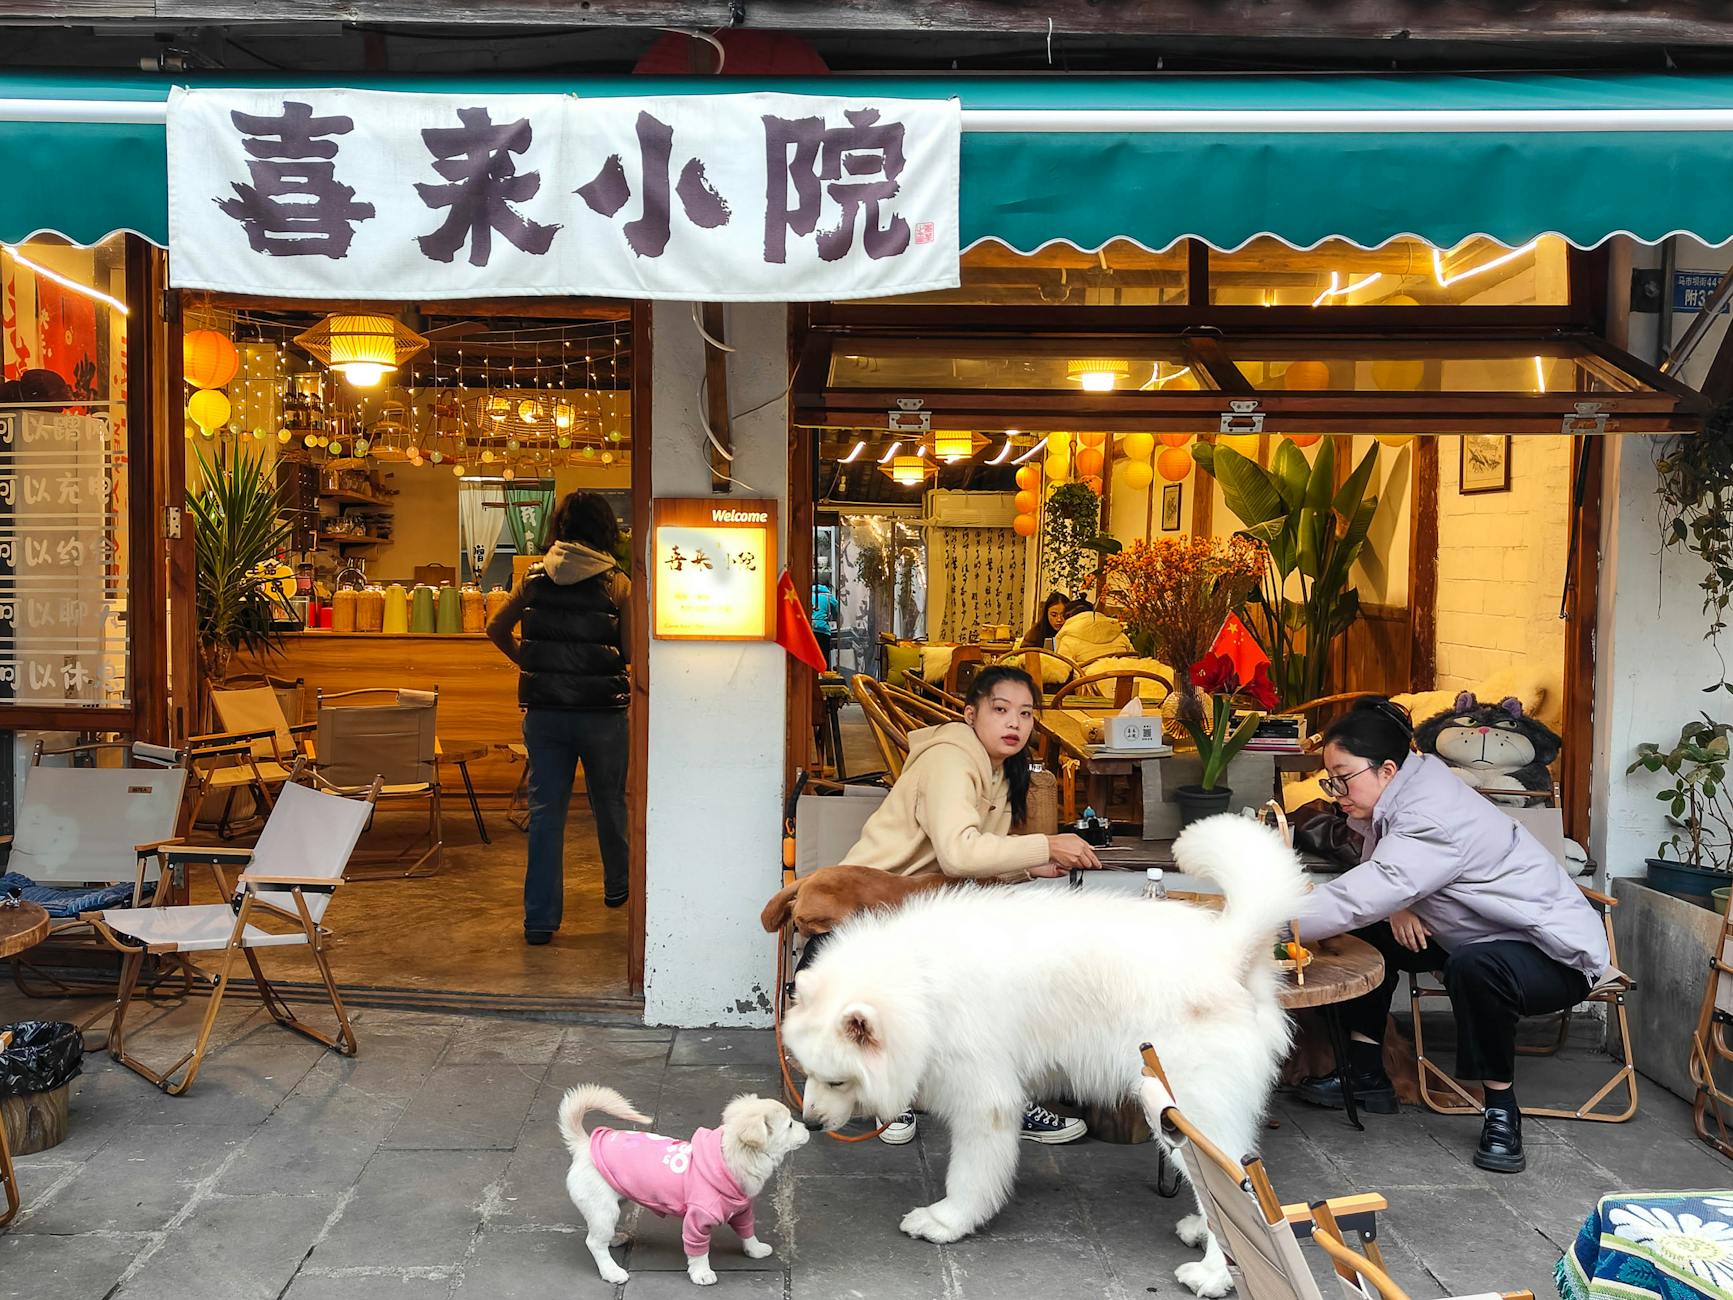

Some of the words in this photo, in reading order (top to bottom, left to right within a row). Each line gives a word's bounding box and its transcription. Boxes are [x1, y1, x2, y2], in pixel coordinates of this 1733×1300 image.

[211, 101, 911, 266] 喜来小院
[0, 472, 112, 505] 可以充电
[711, 509, 768, 523] Welcome
[0, 536, 115, 567] 可以约会
[0, 660, 120, 691] 可以休息
